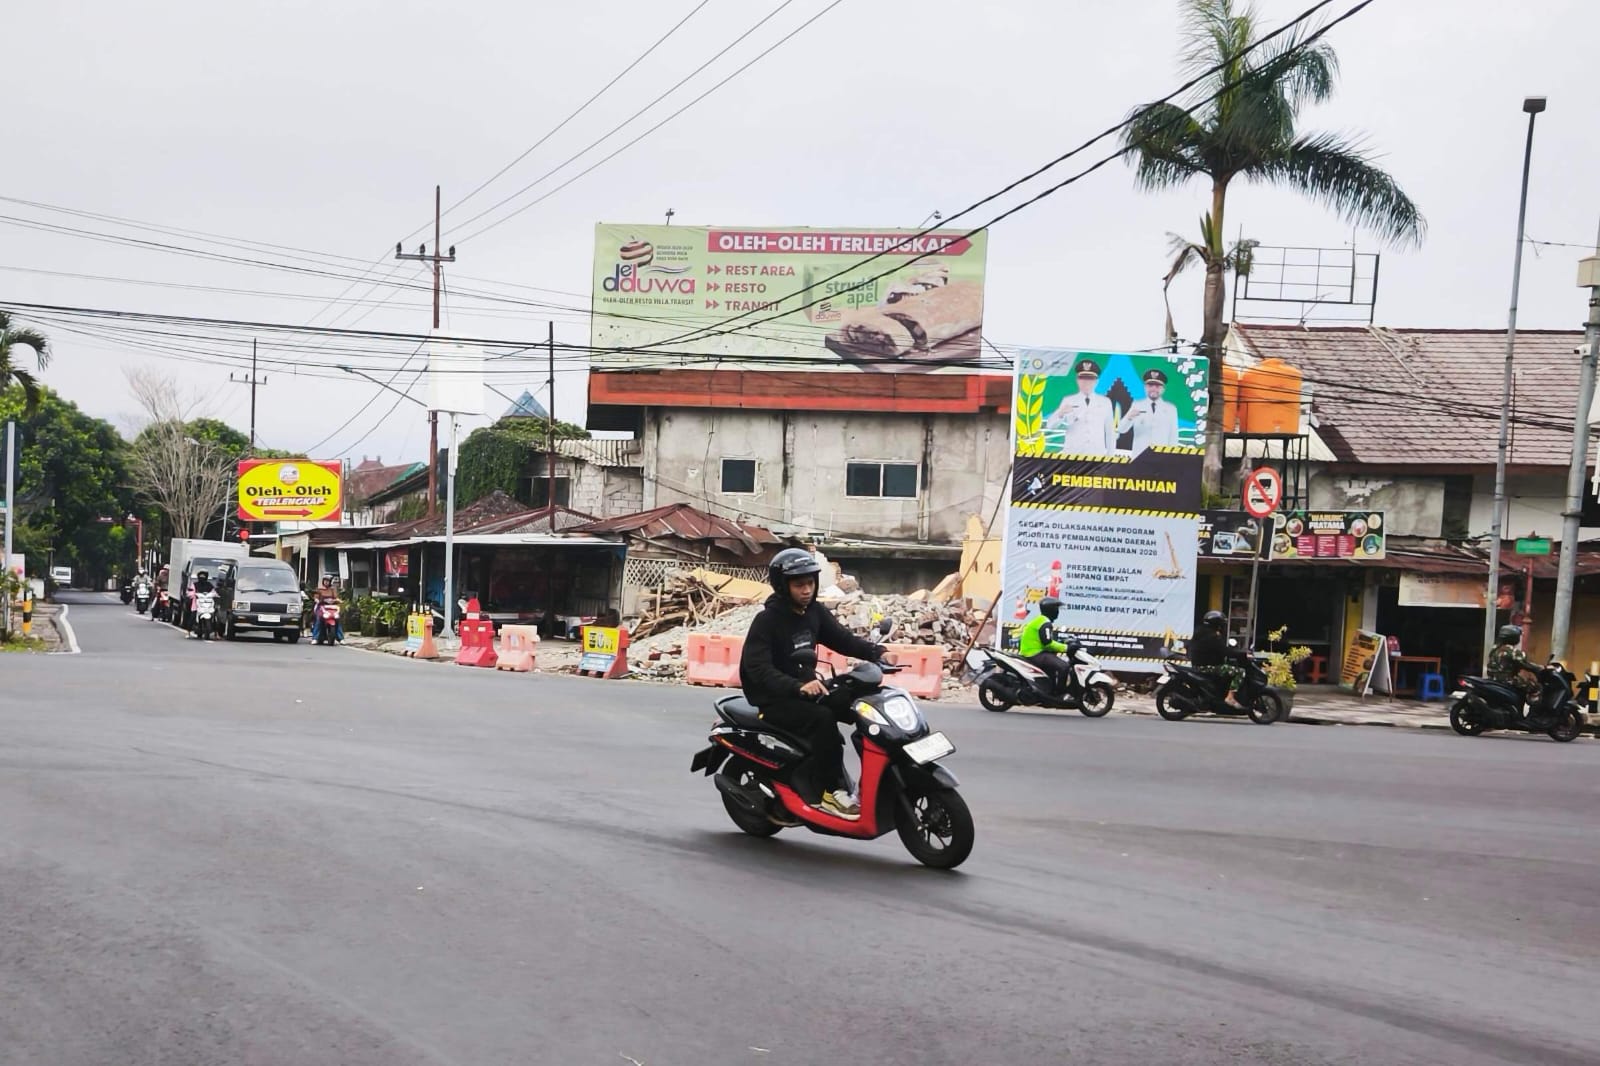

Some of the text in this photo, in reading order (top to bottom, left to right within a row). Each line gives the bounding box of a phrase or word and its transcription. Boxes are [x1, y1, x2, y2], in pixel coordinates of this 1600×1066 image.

[719, 235, 952, 253] OLEH-OLEH TERLENGKAP
[725, 265, 795, 276] REST AREA
[725, 282, 767, 293] RESTO
[725, 300, 779, 312] TRANSIT
[1052, 474, 1177, 494] PEMBERITAHUAN
[246, 486, 282, 496] Oleh
[295, 485, 332, 496] Oleh
[257, 497, 325, 506] TERLENGKAP
[1051, 522, 1114, 533] DILAKSANAKAN
[1116, 527, 1155, 535] PROGRAM
[1061, 534, 1123, 543] PEMBANGUNAN
[1124, 538, 1157, 546] DAERAH
[1017, 540, 1038, 548] KOTA
[1040, 541, 1061, 550] BATU
[1064, 543, 1091, 551] TAHUN
[1093, 545, 1137, 554] ANGGARAN
[1066, 564, 1143, 575] PRESERVASI JALAN
[1066, 573, 1129, 582] SIMPANG EMPAT
[1104, 605, 1130, 614] EMPAT
